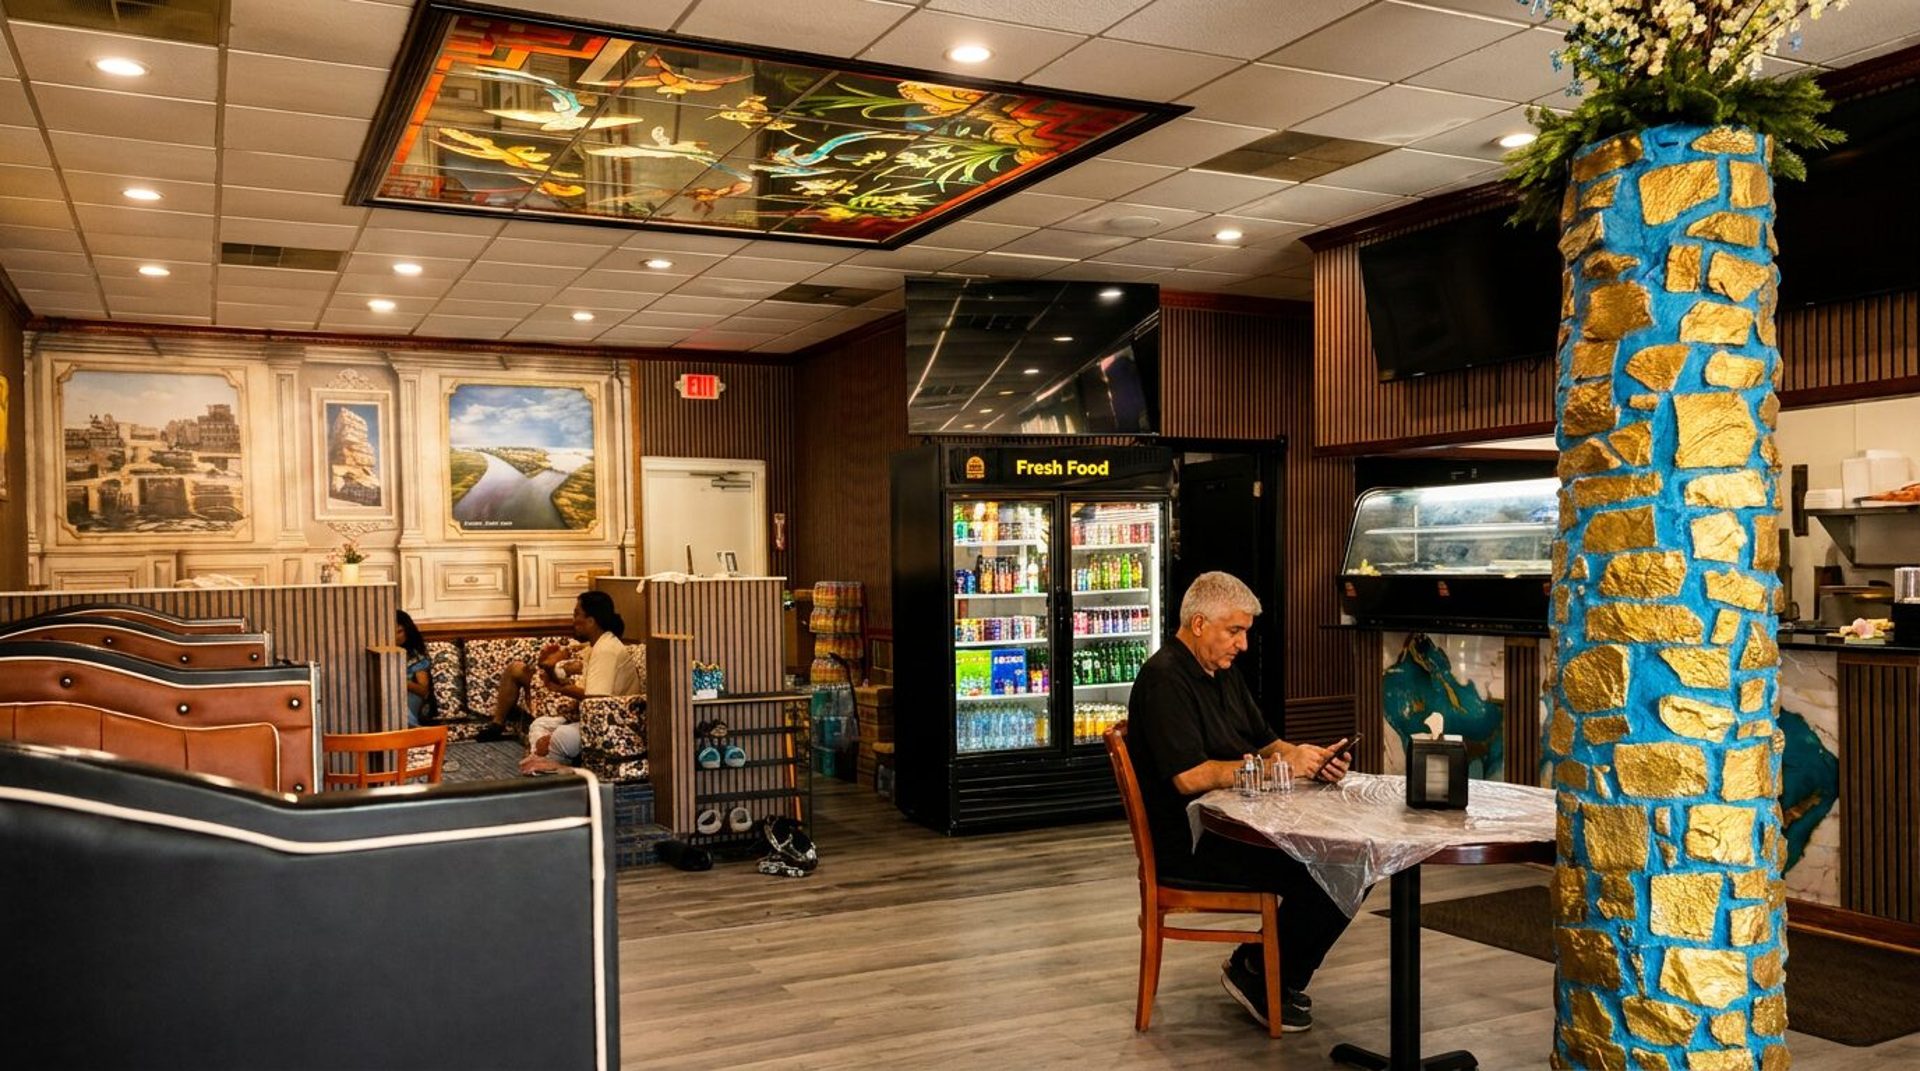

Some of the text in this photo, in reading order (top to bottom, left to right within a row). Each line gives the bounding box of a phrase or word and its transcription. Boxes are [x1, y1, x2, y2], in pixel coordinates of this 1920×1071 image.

[687, 376, 715, 397] EXIT
[1016, 459, 1109, 476] Fresh Food
